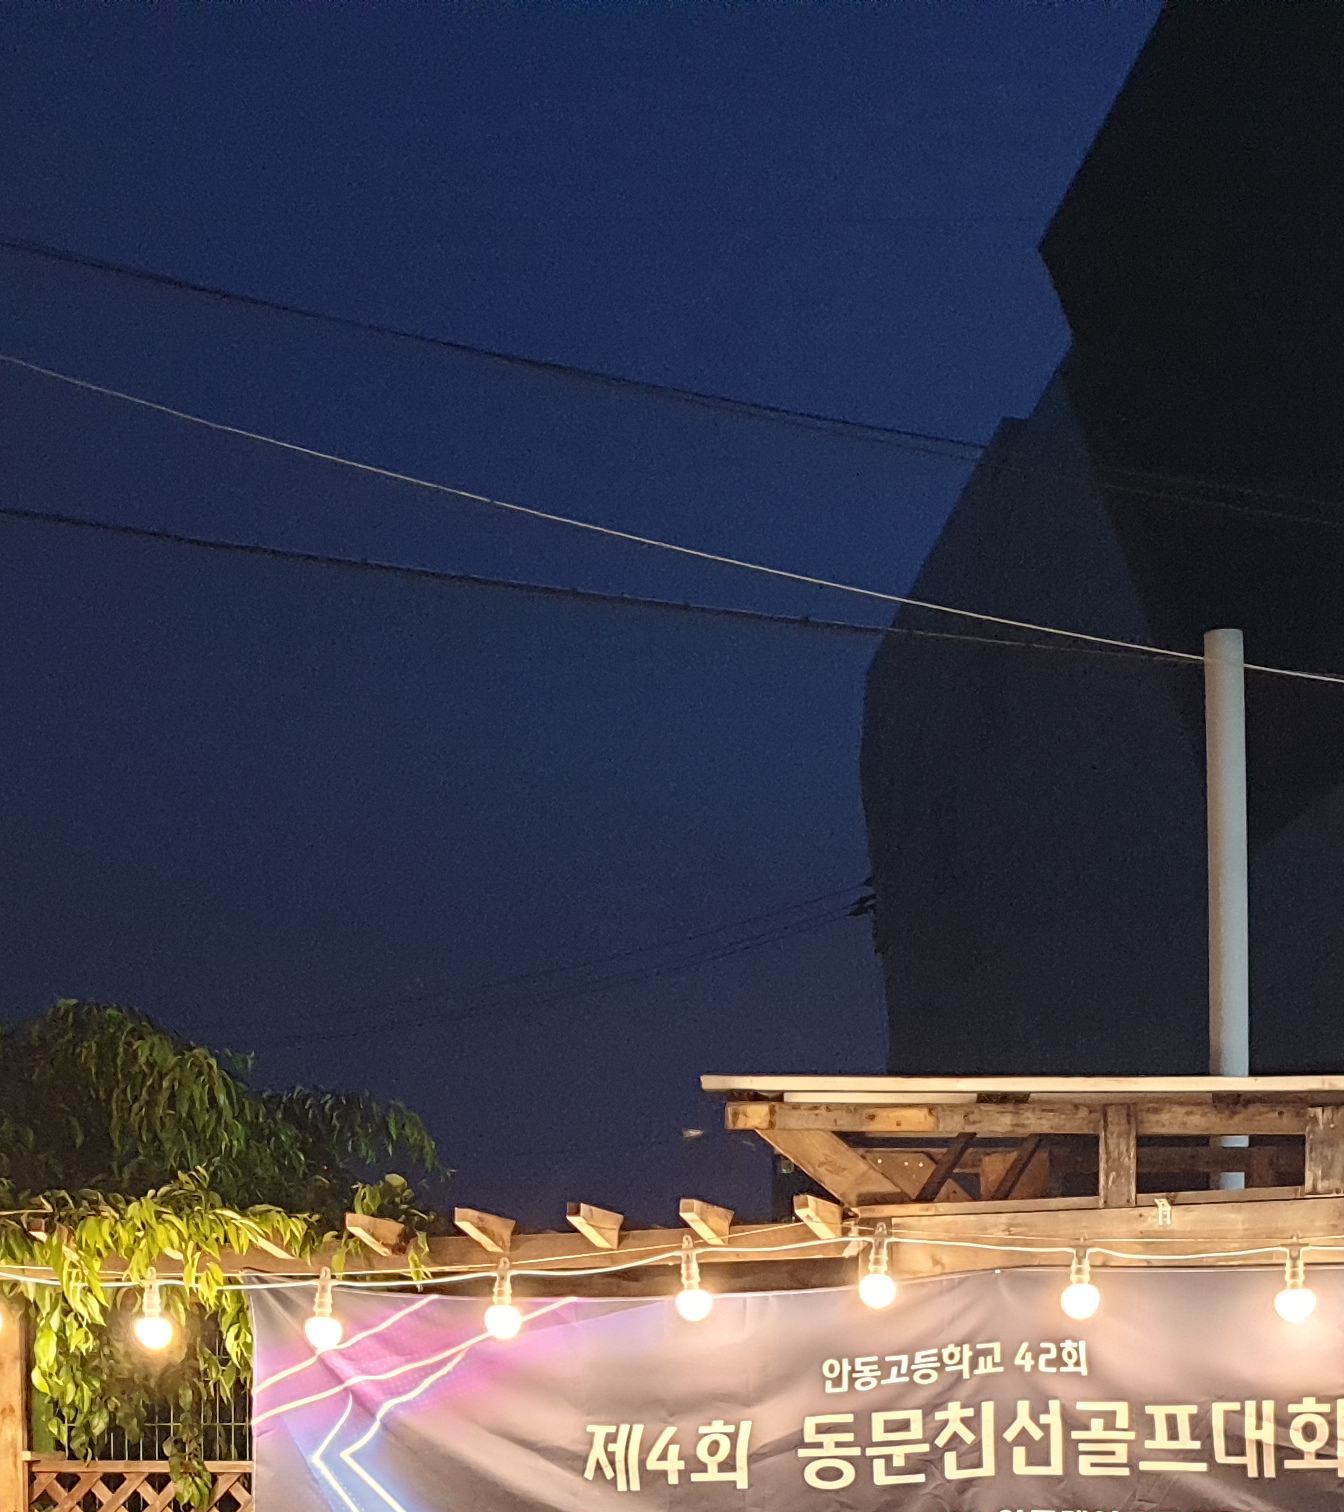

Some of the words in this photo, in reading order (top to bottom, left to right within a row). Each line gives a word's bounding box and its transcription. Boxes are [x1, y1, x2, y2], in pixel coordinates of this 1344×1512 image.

[822, 1341, 1004, 1393] 안동고등학교
[1014, 1340, 1088, 1376] 42회
[583, 1418, 753, 1492] 제4회
